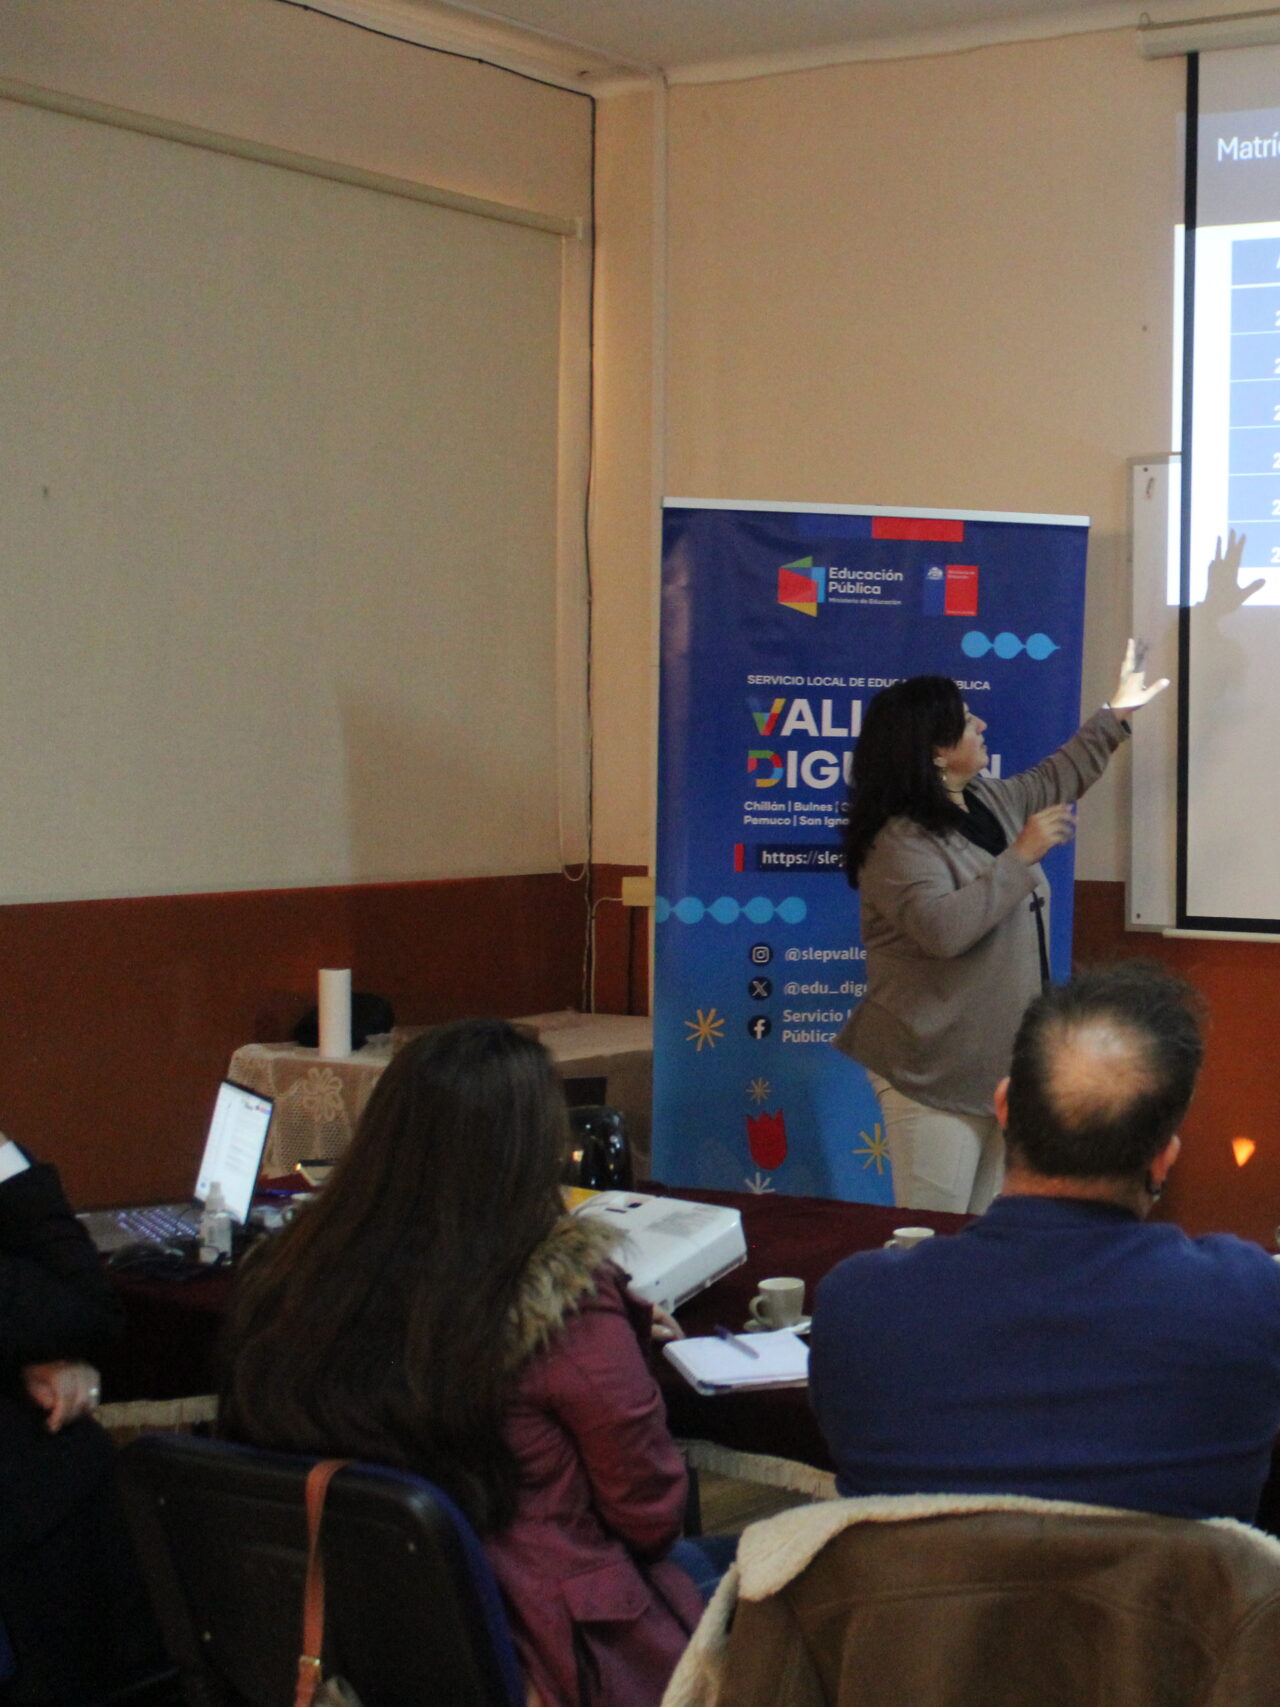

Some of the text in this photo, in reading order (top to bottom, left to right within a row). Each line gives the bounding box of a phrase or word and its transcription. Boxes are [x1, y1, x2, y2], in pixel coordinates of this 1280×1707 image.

[828, 567, 903, 581] Educación
[828, 581, 881, 595] Pública
[747, 675, 804, 686] SERVICIO
[807, 676, 847, 687] LOCAL
[849, 677, 865, 687] DE
[743, 801, 785, 811] Chillán
[793, 801, 833, 811] Bulnes
[799, 816, 822, 826] San
[824, 816, 850, 828] Igna
[784, 947, 867, 963] @slepvalle
[784, 981, 867, 997] @edu_dig
[783, 1008, 843, 1022] Servicio
